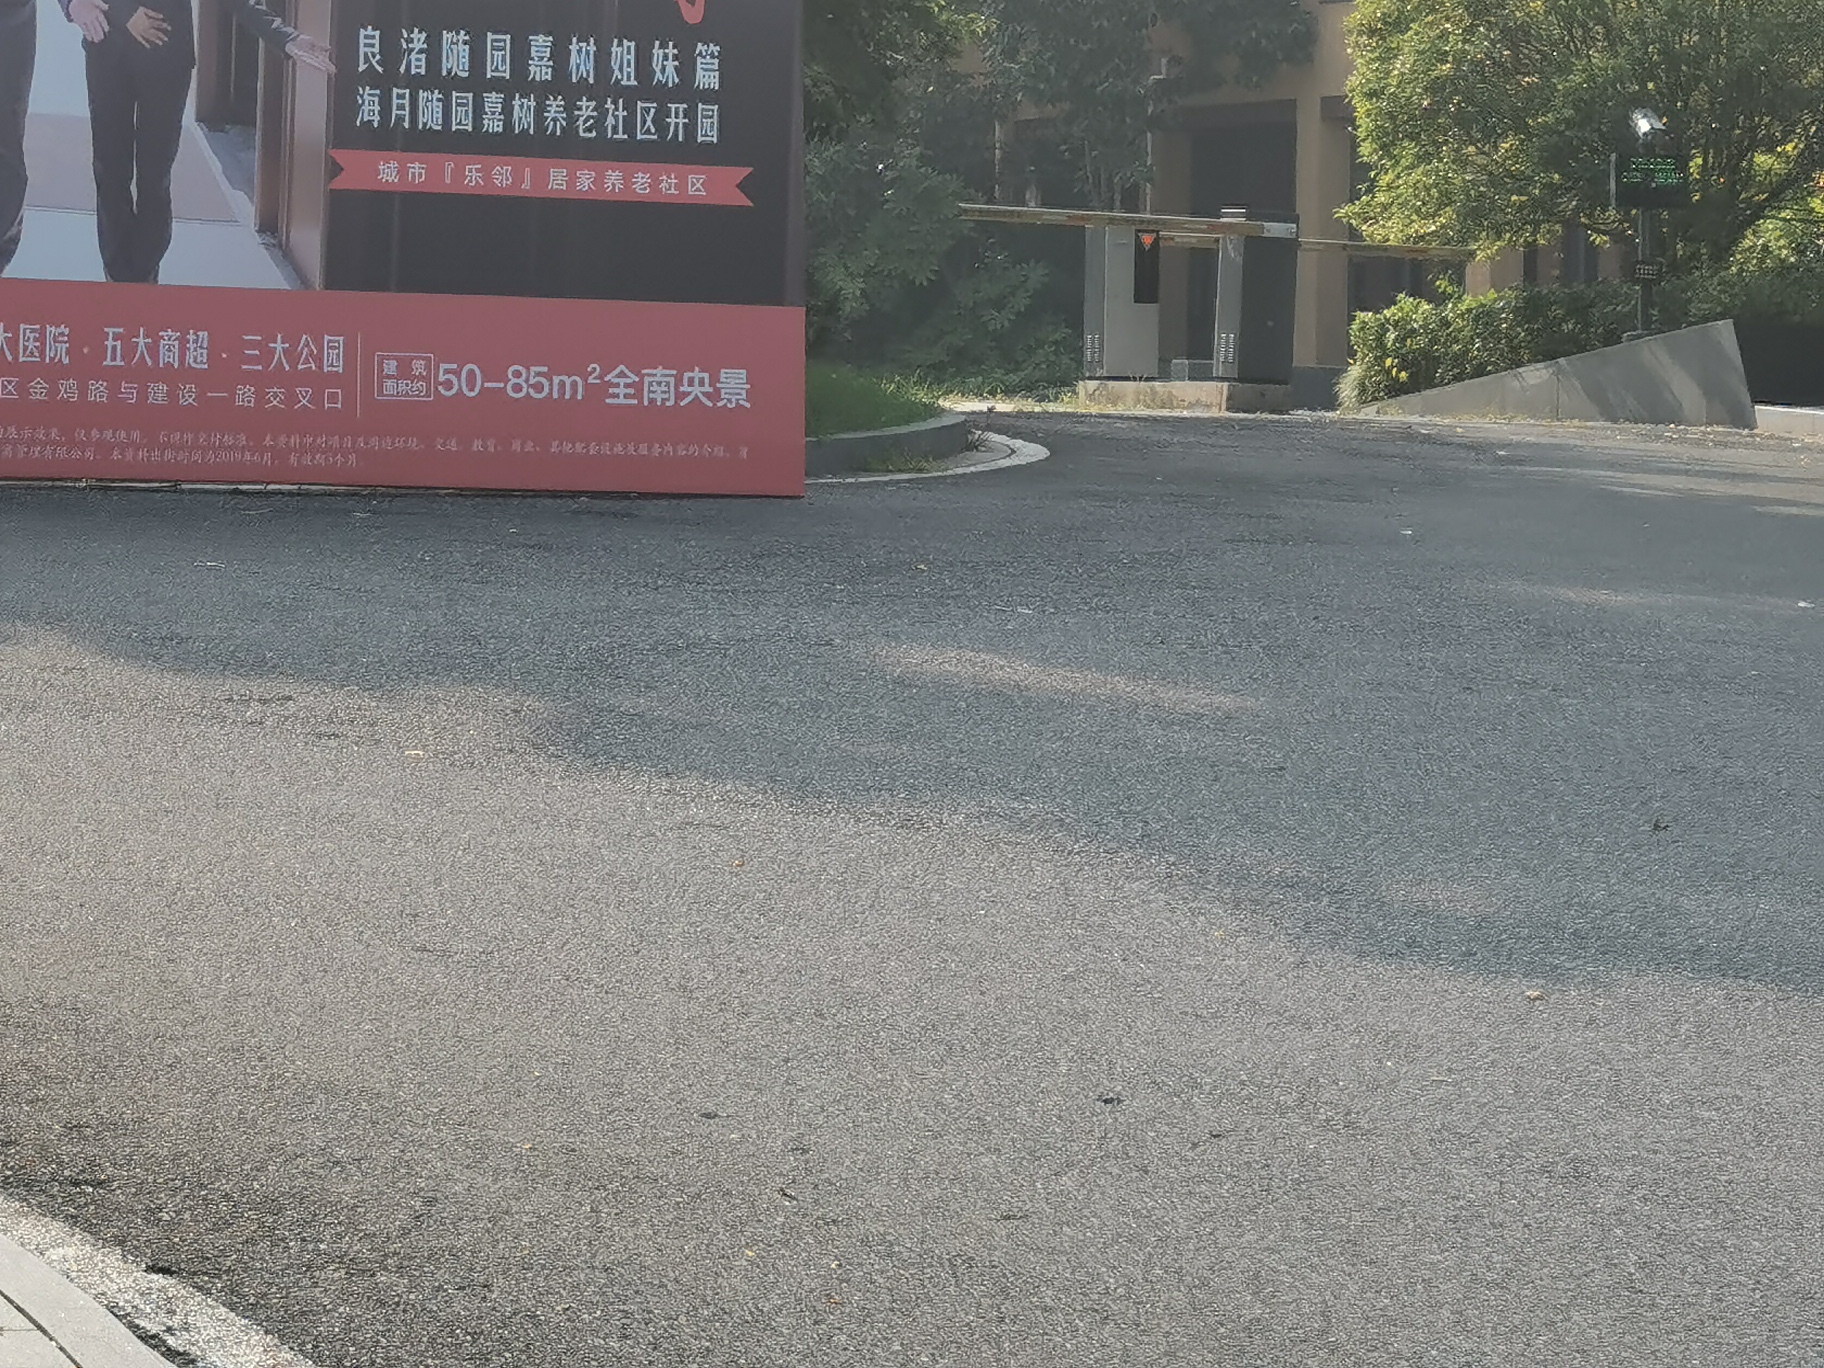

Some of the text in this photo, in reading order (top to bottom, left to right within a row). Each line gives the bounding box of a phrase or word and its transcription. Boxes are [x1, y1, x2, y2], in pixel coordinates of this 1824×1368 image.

[356, 24, 722, 90] 良渚随园嘉树姐妹篇
[355, 85, 721, 145] 海月随园嘉树养老社区开园
[382, 378, 428, 397] 面积约
